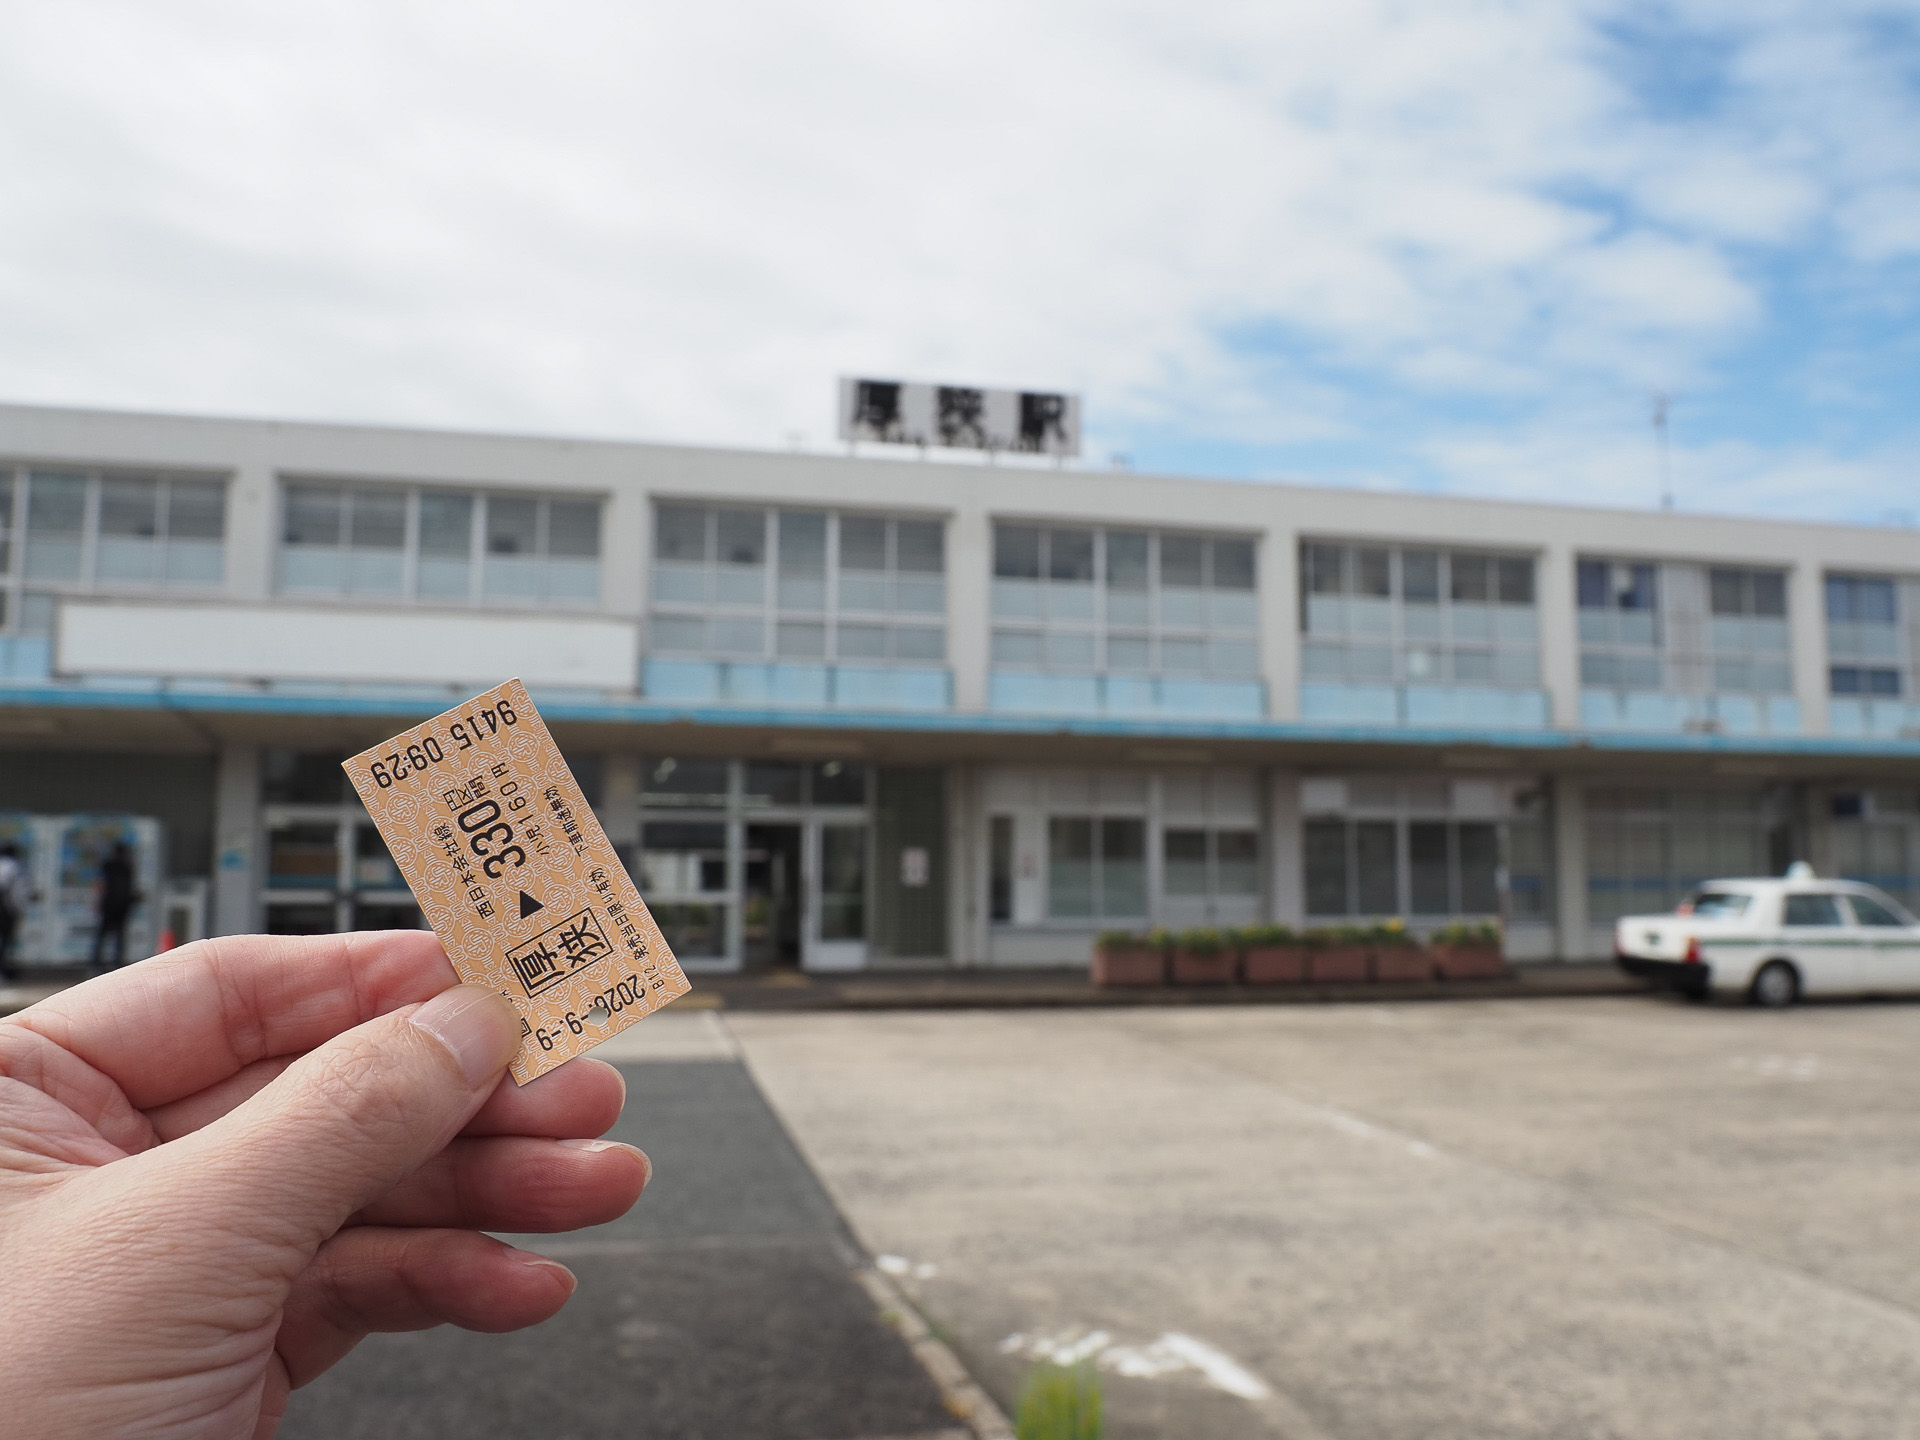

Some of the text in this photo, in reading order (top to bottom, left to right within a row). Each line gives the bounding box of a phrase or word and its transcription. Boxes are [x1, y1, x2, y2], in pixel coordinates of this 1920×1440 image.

[370, 699, 518, 789] 9415 09:29
[433, 822, 496, 920] 西日本会社線
[542, 785, 665, 990] B12 発売当日限り有効 下車前途無効
[512, 916, 606, 991] 厚狭
